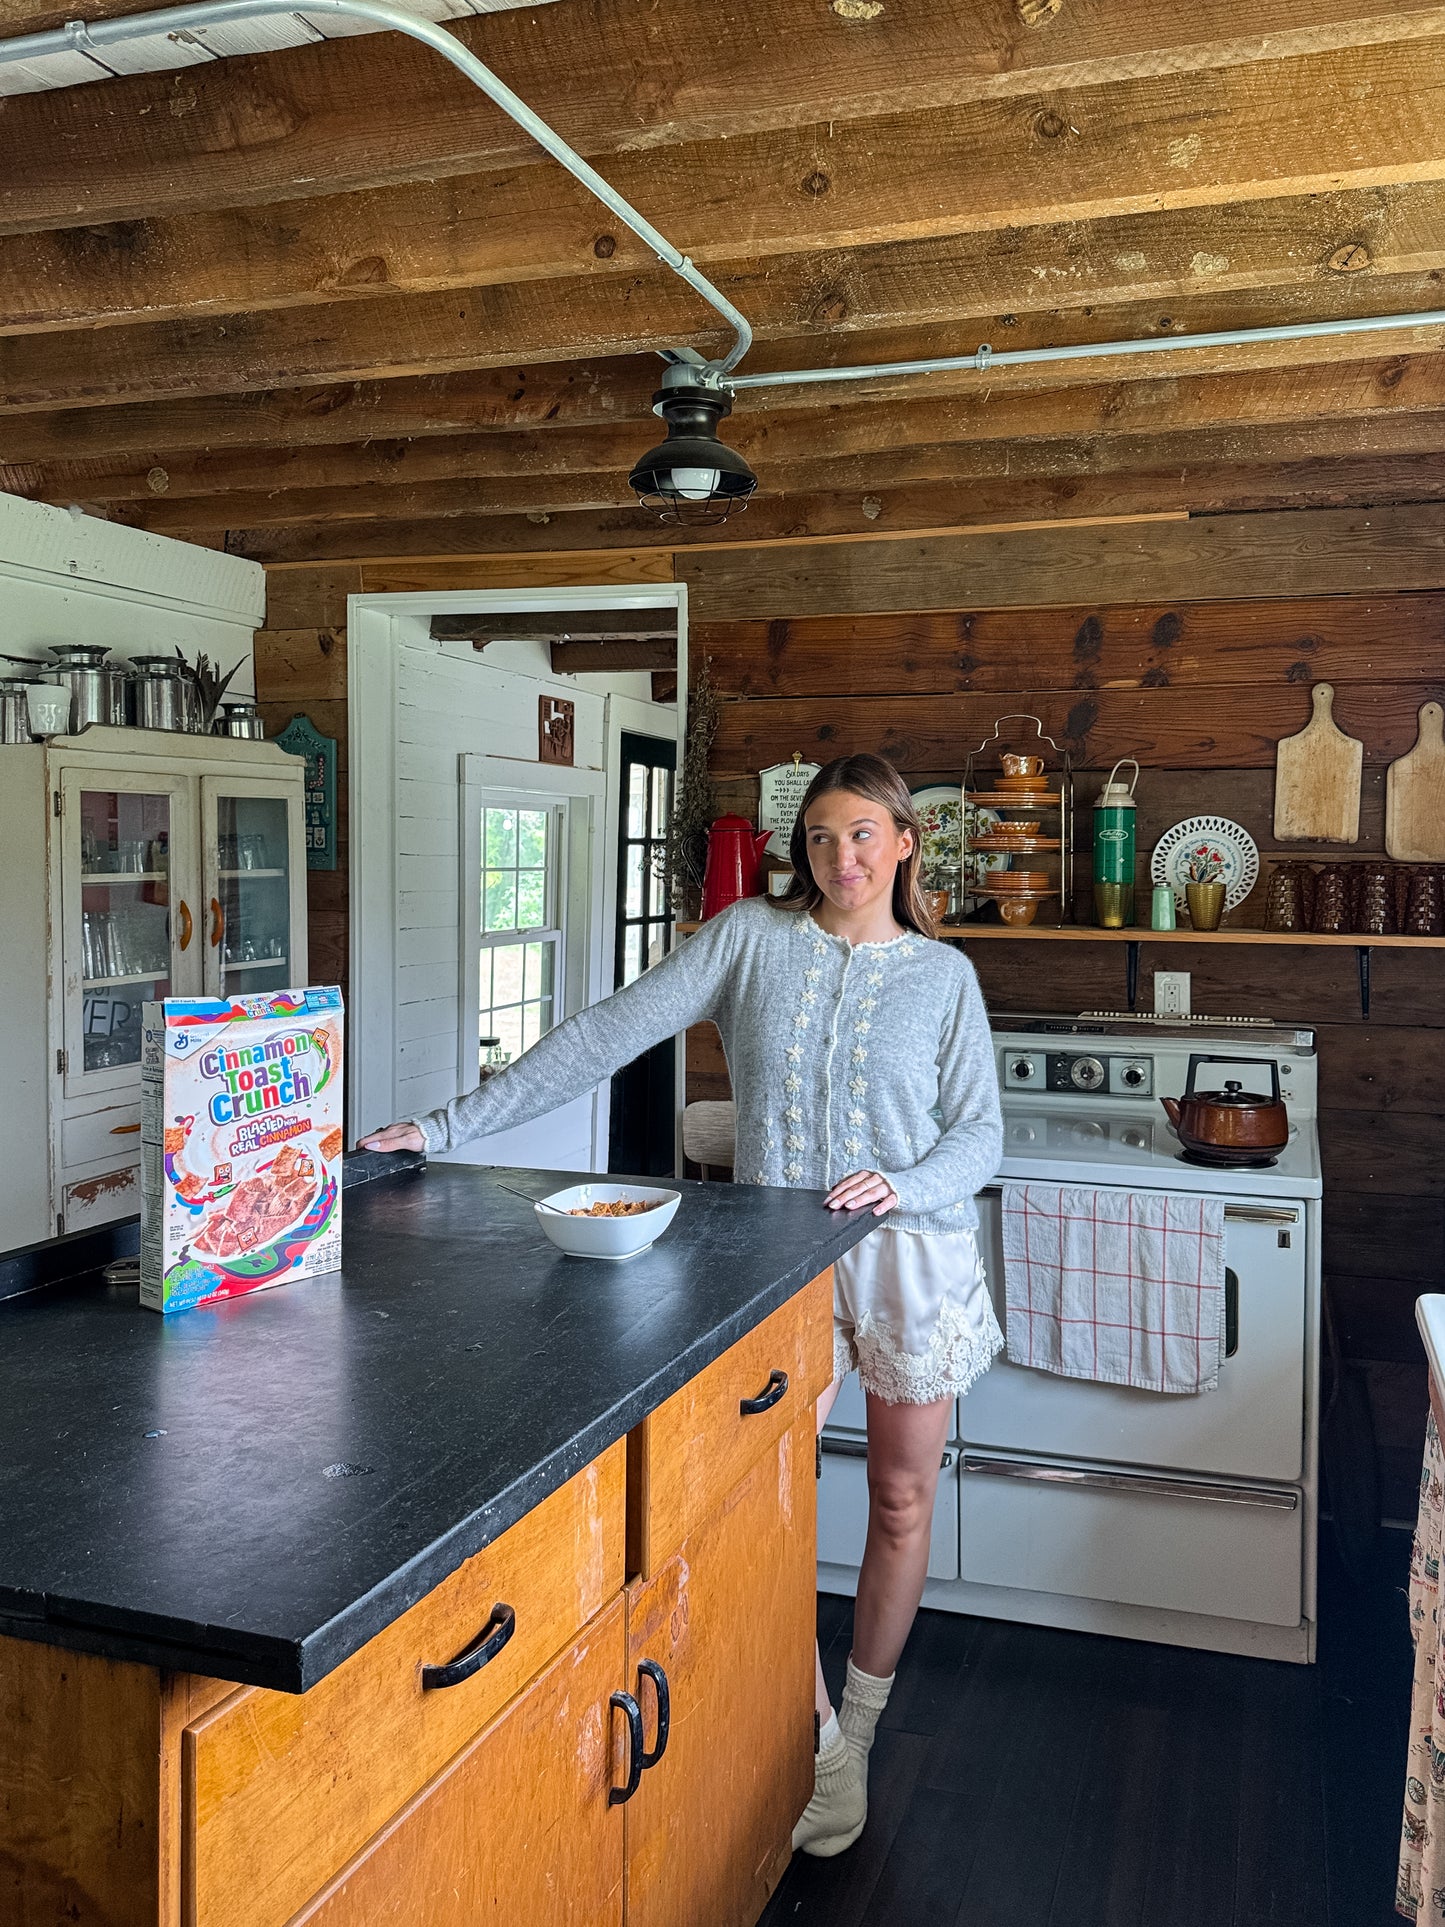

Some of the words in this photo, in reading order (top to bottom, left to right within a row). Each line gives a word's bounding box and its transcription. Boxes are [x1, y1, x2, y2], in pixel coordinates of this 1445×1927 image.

[240, 996, 271, 1006] Cinnamon
[247, 1001, 269, 1010] Toast
[248, 1006, 276, 1018] Crunch
[204, 1033, 308, 1075] Cinnamon
[225, 1056, 292, 1094] Toast
[212, 1071, 310, 1122] Crunch
[231, 1140, 260, 1156] REAL
[259, 1120, 311, 1146] CINNAMON
[238, 1116, 284, 1141] BLASTED
[284, 1116, 297, 1126] WITH
